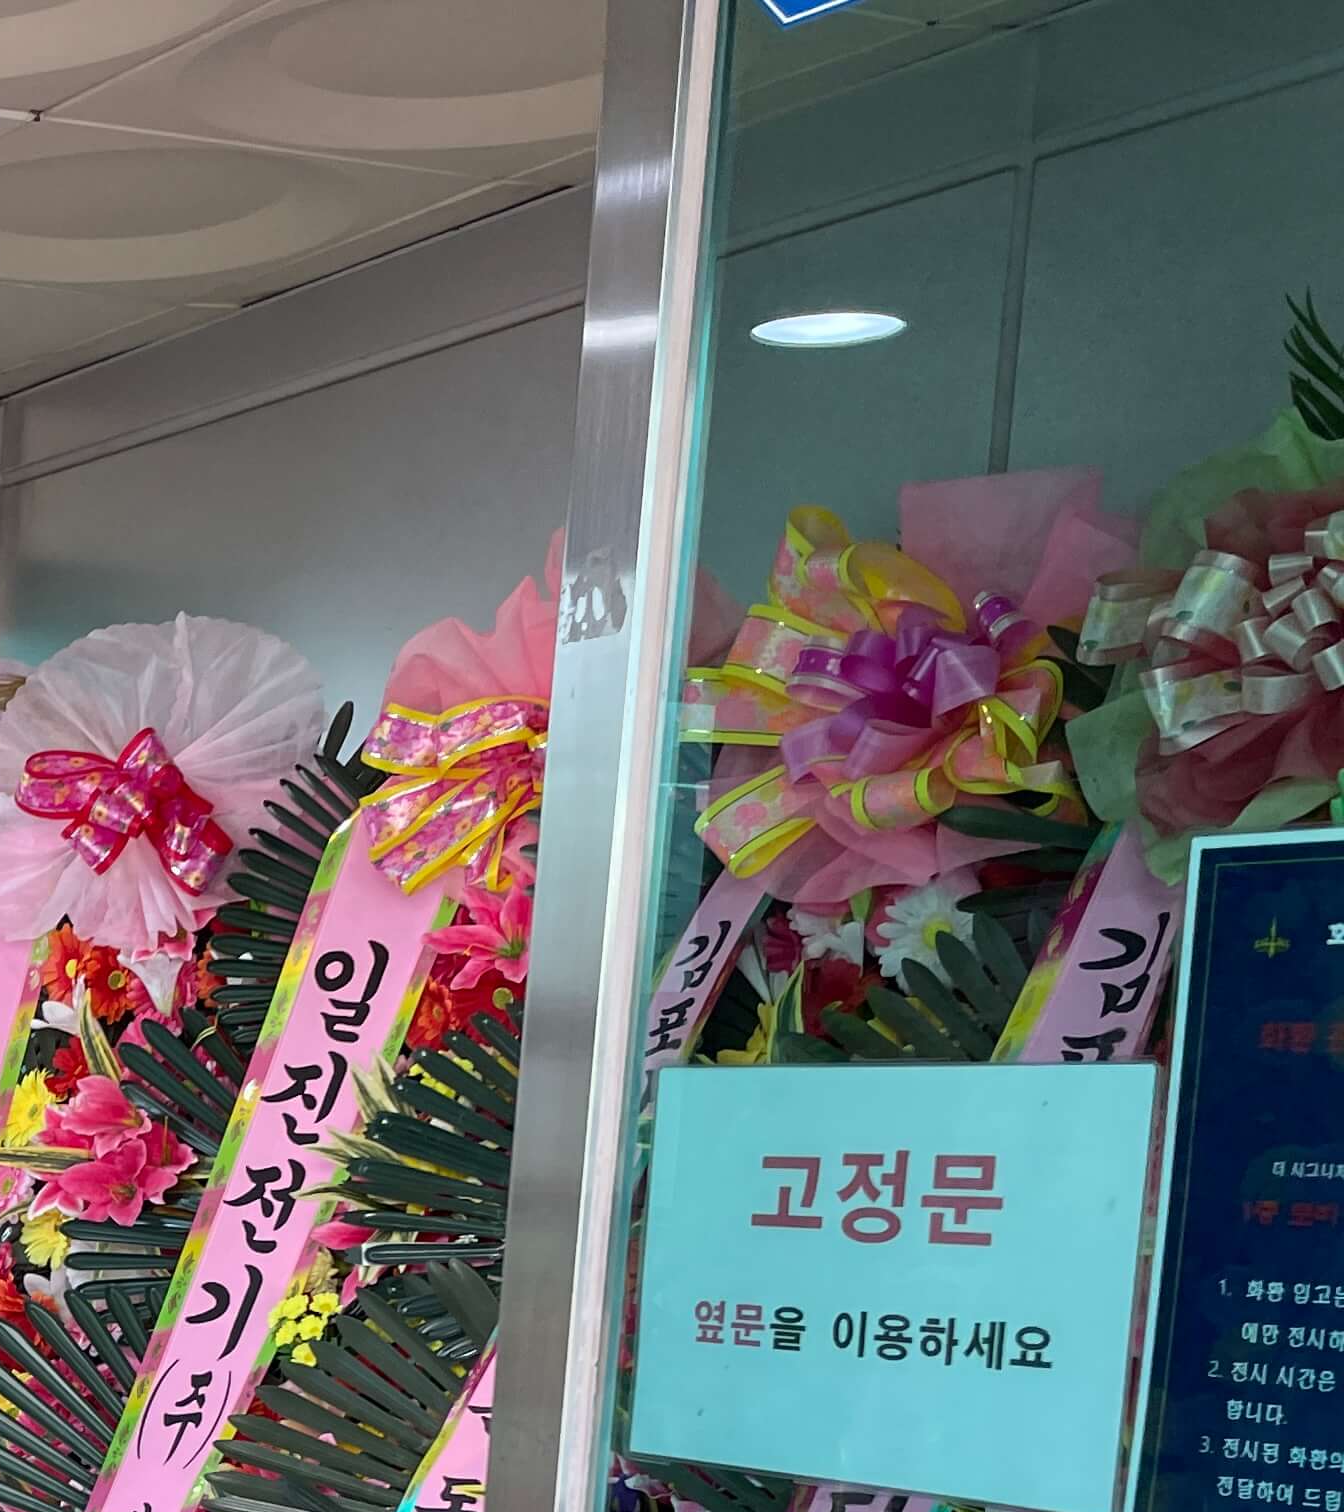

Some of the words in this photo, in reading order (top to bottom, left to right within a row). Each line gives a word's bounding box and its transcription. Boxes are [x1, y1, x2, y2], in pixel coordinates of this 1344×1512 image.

[750, 1149, 1005, 1247] 고정문
[693, 1299, 807, 1352] 옆문을
[831, 1310, 1054, 1371] 이용하세요
[1231, 1361, 1268, 1386] 전시
[1275, 1365, 1336, 1393] 시간은
[1223, 1437, 1280, 1464] 전시된
[1216, 1475, 1294, 1506] 전달하여
